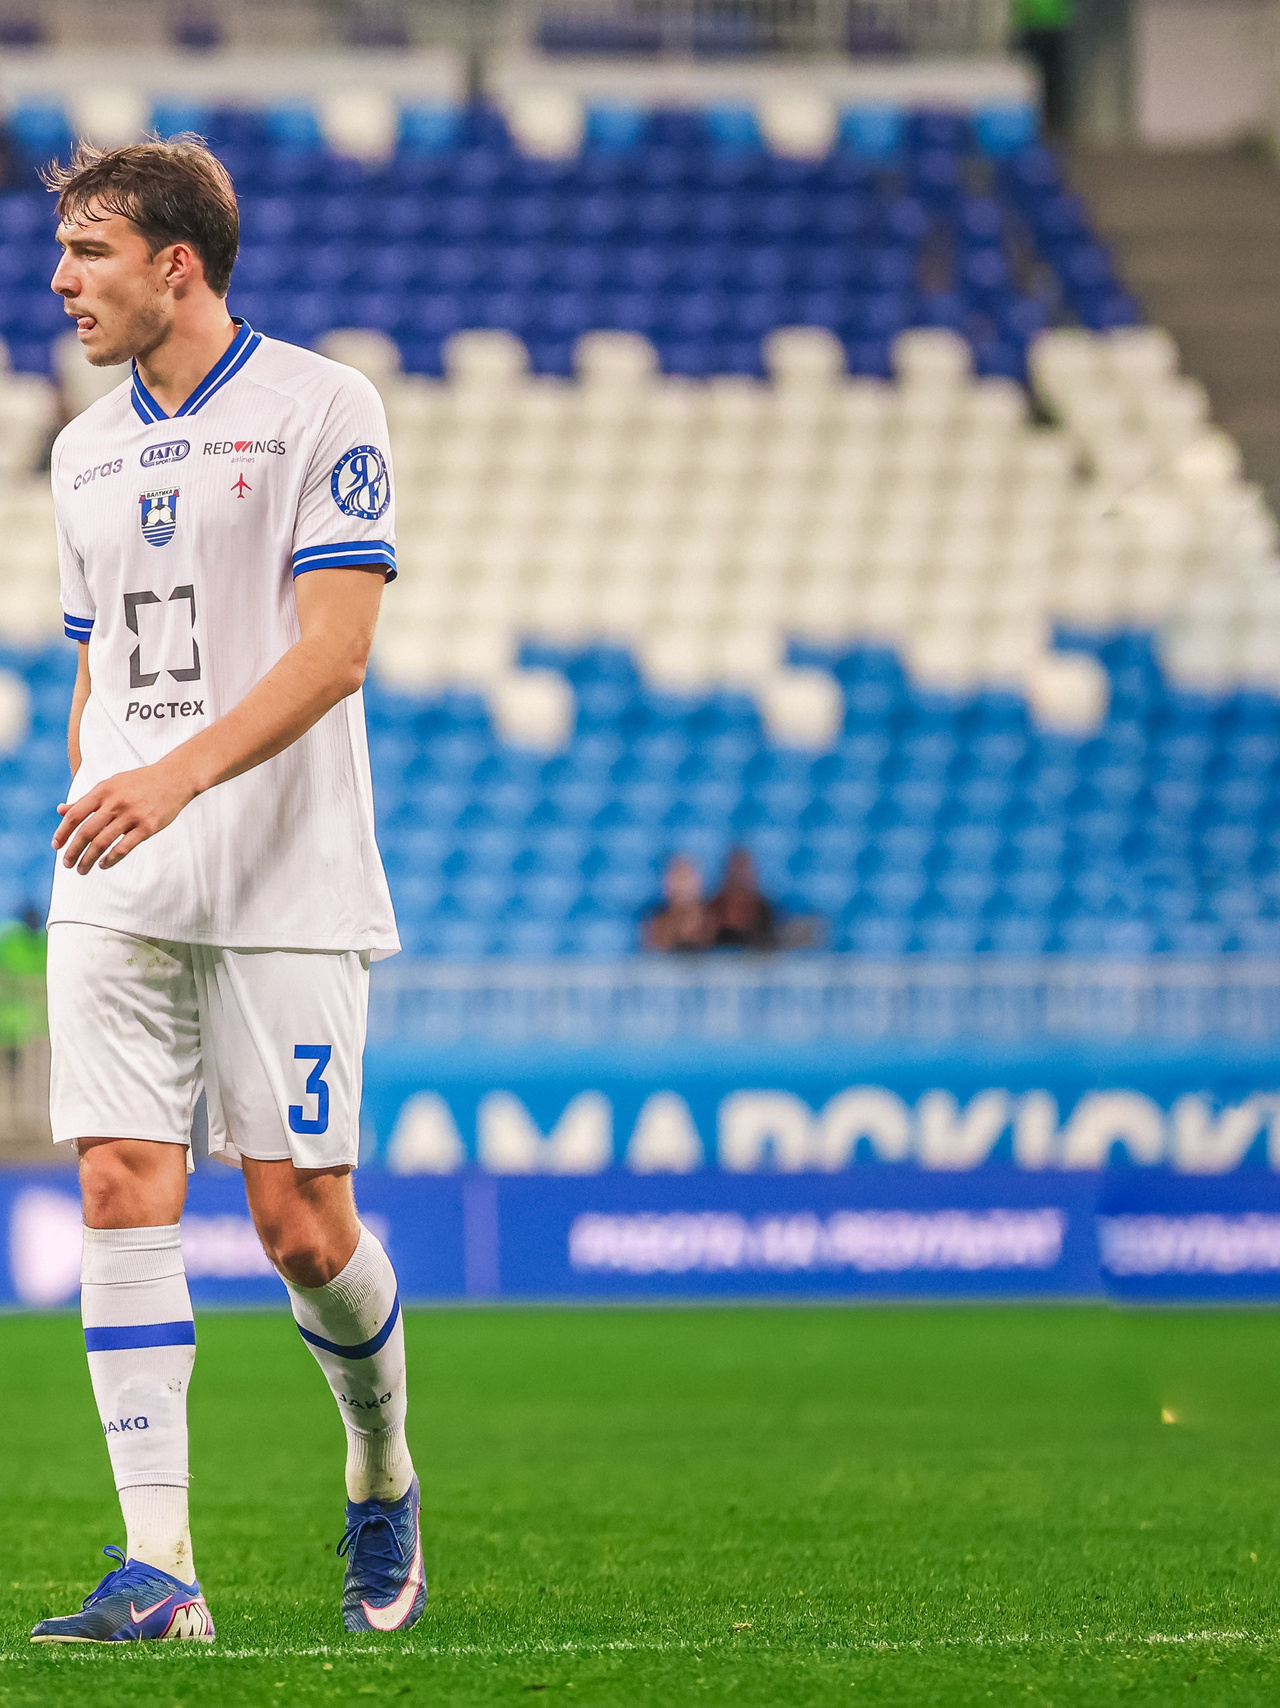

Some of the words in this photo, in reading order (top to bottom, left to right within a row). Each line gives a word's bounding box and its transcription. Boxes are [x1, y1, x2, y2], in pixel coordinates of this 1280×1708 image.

[145, 444, 186, 462] JAKO
[155, 458, 172, 466] SPORT
[231, 455, 255, 463] airlines
[146, 489, 173, 499] БАЛТИКА
[125, 700, 205, 721] Ростех
[288, 1044, 332, 1134] 3
[339, 1391, 392, 1409] JAKO
